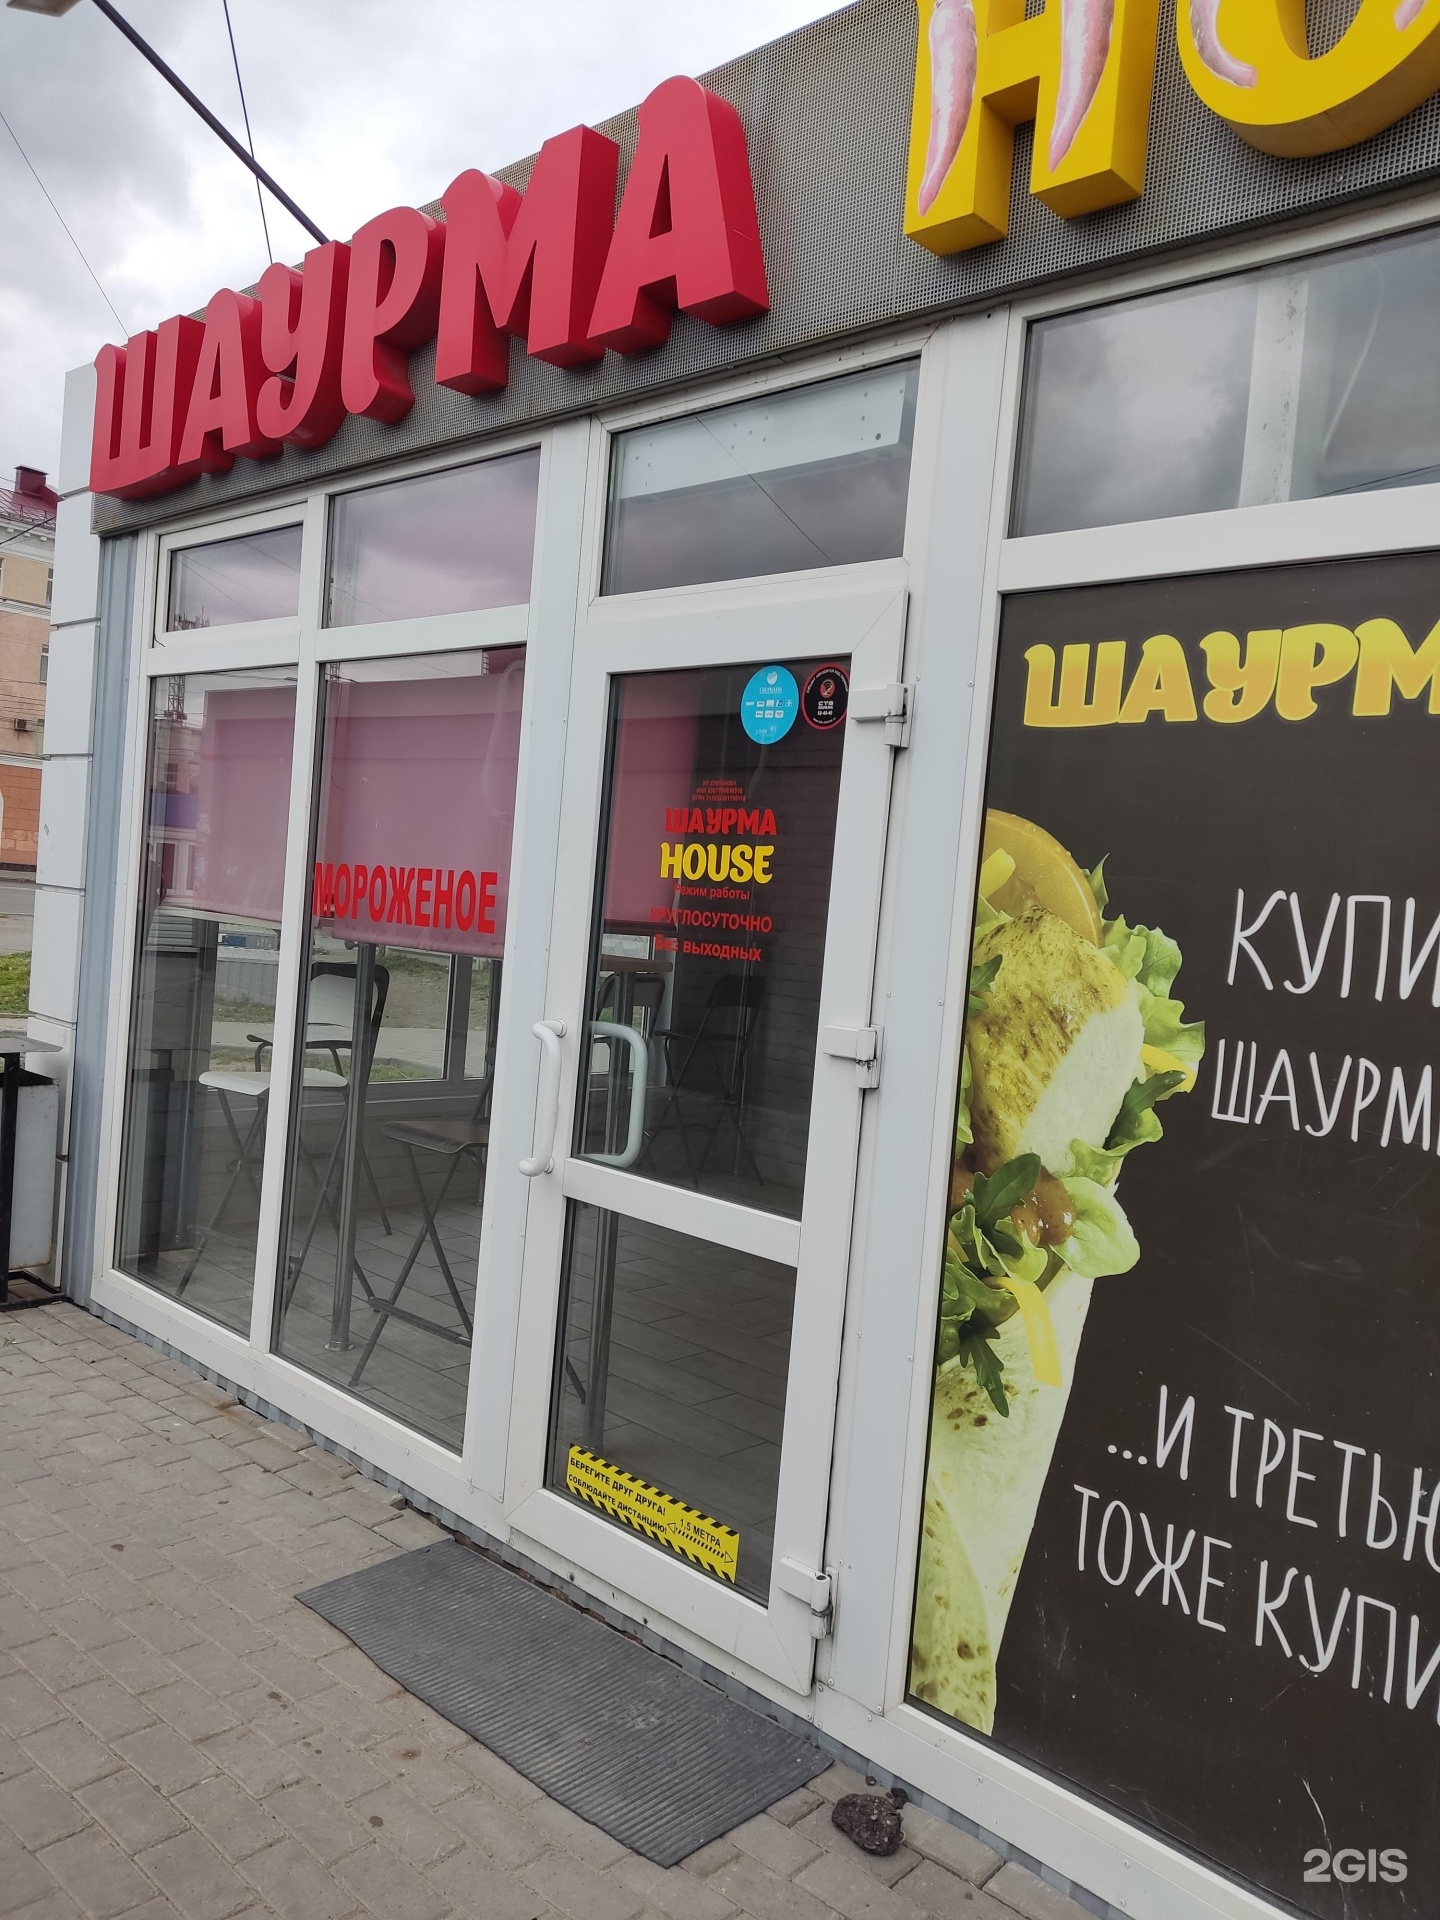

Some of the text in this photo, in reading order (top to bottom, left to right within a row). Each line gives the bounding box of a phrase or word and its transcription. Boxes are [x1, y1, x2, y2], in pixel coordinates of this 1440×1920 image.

[89, 74, 770, 500] ШАУРМА
[665, 807, 777, 836] ШАУРМА
[660, 842, 775, 884] HOUSE
[313, 863, 498, 934] МОРОЖЕНОЕ
[673, 883, 750, 900] Режим работы
[649, 907, 773, 933] КРУГЛОСУТОЧНО
[655, 933, 762, 961] Без выходных
[1212, 1038, 1440, 1157] ШАУРМ
[568, 1473, 668, 1535] СОБЛЮДАЙТЕ ДИСТАНЦИЮ!
[570, 1457, 666, 1517] БЕРЕГИТЕ ДРУГ ДРУГА!
[680, 1518, 721, 1549] 1,5 МЕТРА
[1073, 1483, 1233, 1633] ТОЖЕ
